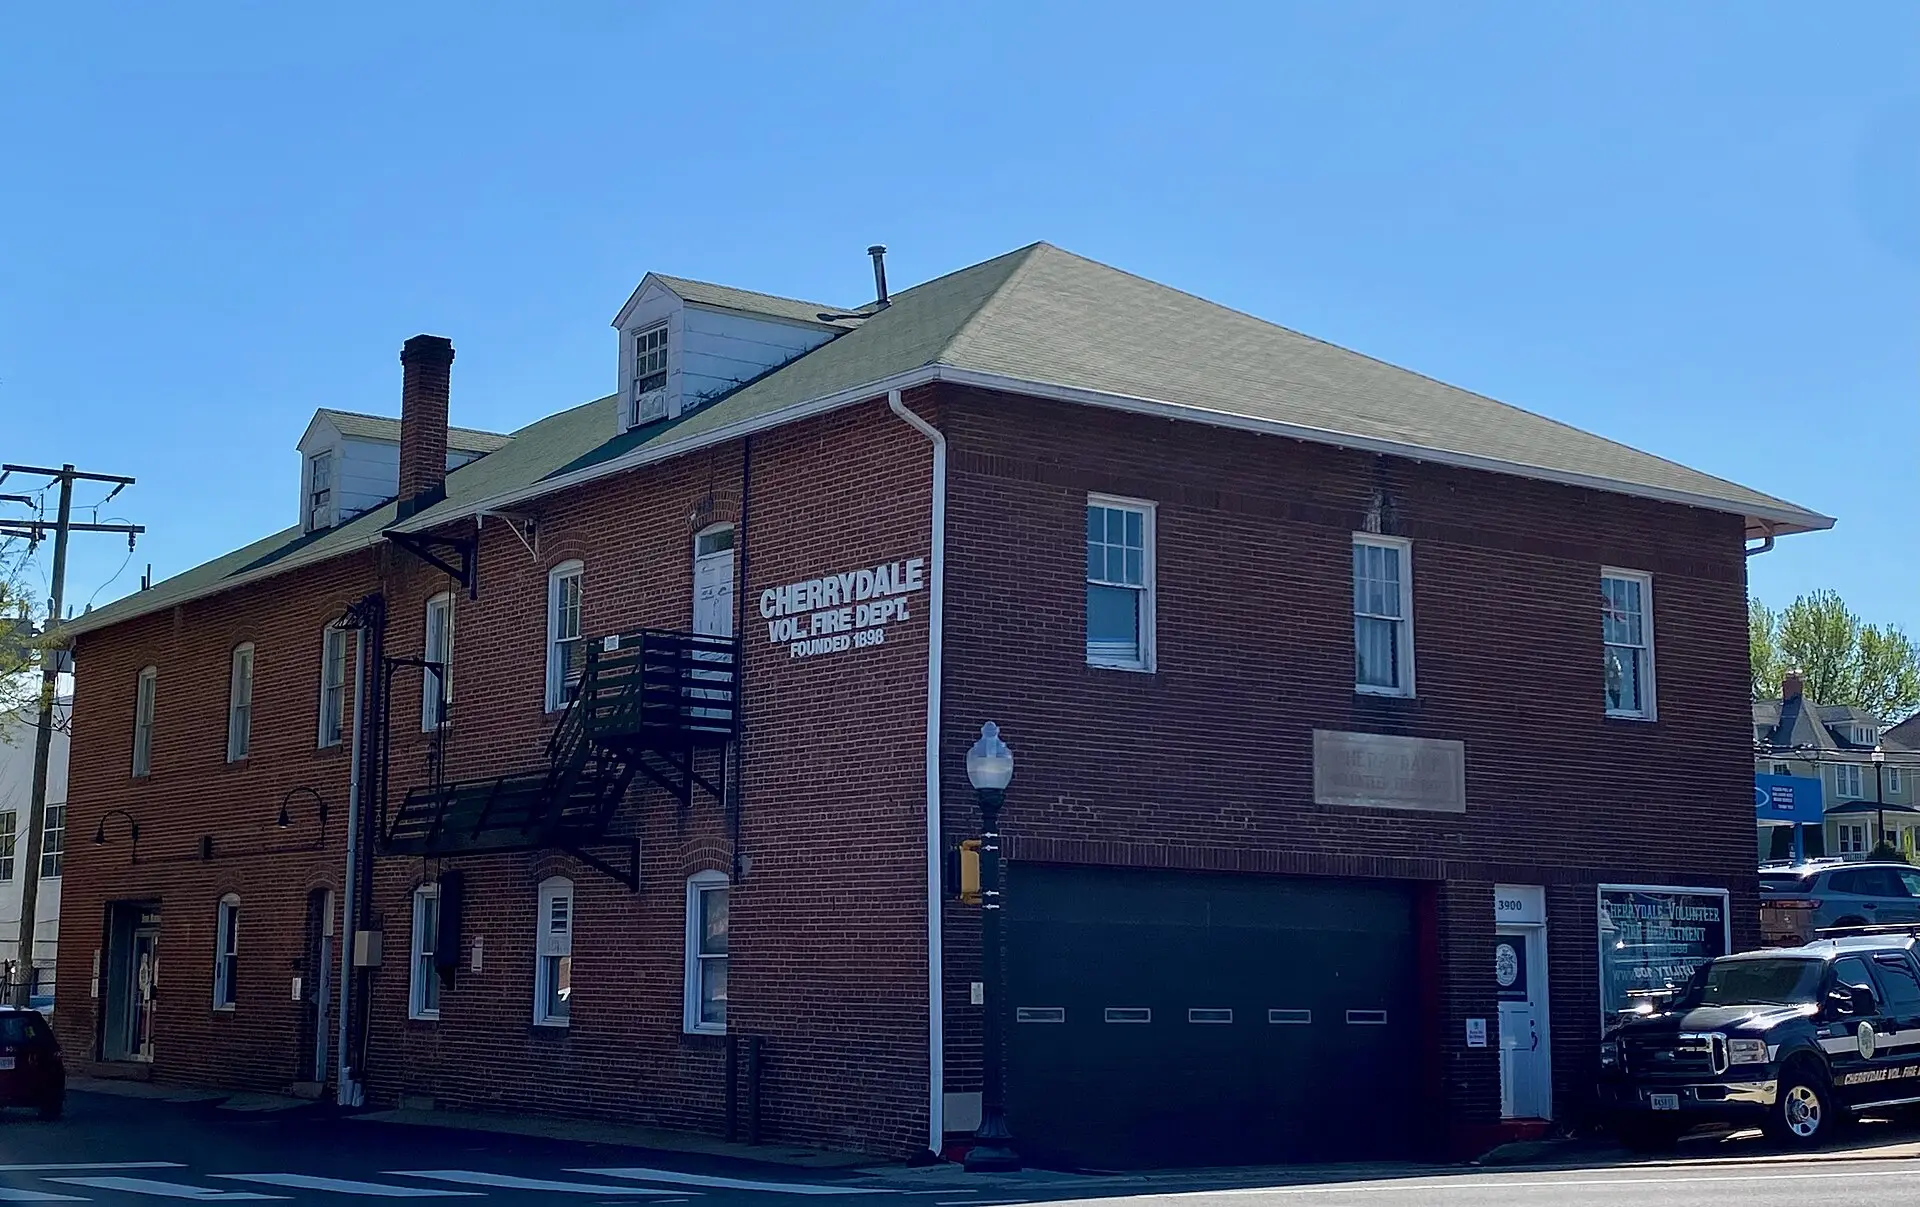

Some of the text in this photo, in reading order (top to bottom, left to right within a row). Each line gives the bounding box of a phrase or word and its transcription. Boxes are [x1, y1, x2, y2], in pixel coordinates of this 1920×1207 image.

[759, 558, 924, 619] CHERRYDALE
[768, 597, 910, 643] VOL. FIRE DEPT.
[790, 628, 885, 658] FOUNDED 1898
[1498, 900, 1522, 911] 3900
[1668, 902, 1720, 922] VOLUNTEER
[1844, 1069, 1887, 1085] CHERRYDALE
[1901, 1065, 1918, 1078] FIRE
